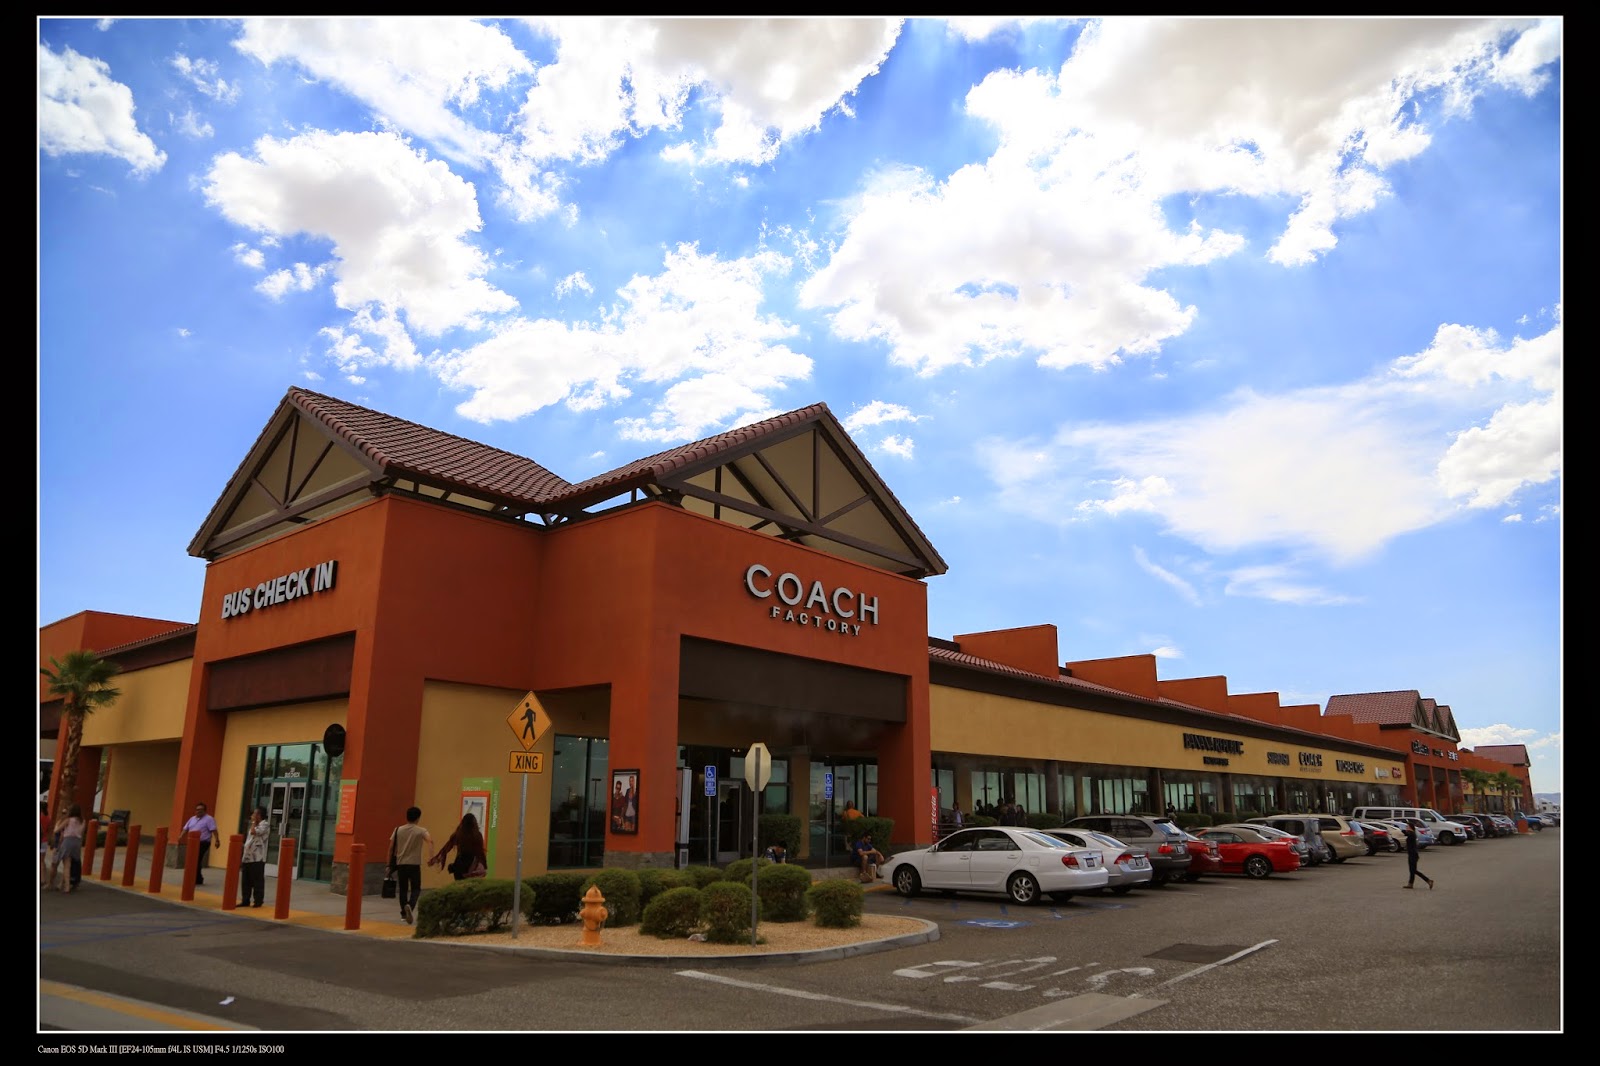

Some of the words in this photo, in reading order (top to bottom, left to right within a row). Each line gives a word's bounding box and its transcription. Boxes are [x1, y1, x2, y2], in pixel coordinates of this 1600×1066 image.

[221, 588, 252, 619] BUS
[254, 567, 312, 609] CHECK
[313, 560, 335, 593] IN
[746, 564, 879, 625] COACH
[771, 606, 861, 636] FACTORY
[515, 755, 538, 770] XING
[1299, 752, 1322, 767] COACH
